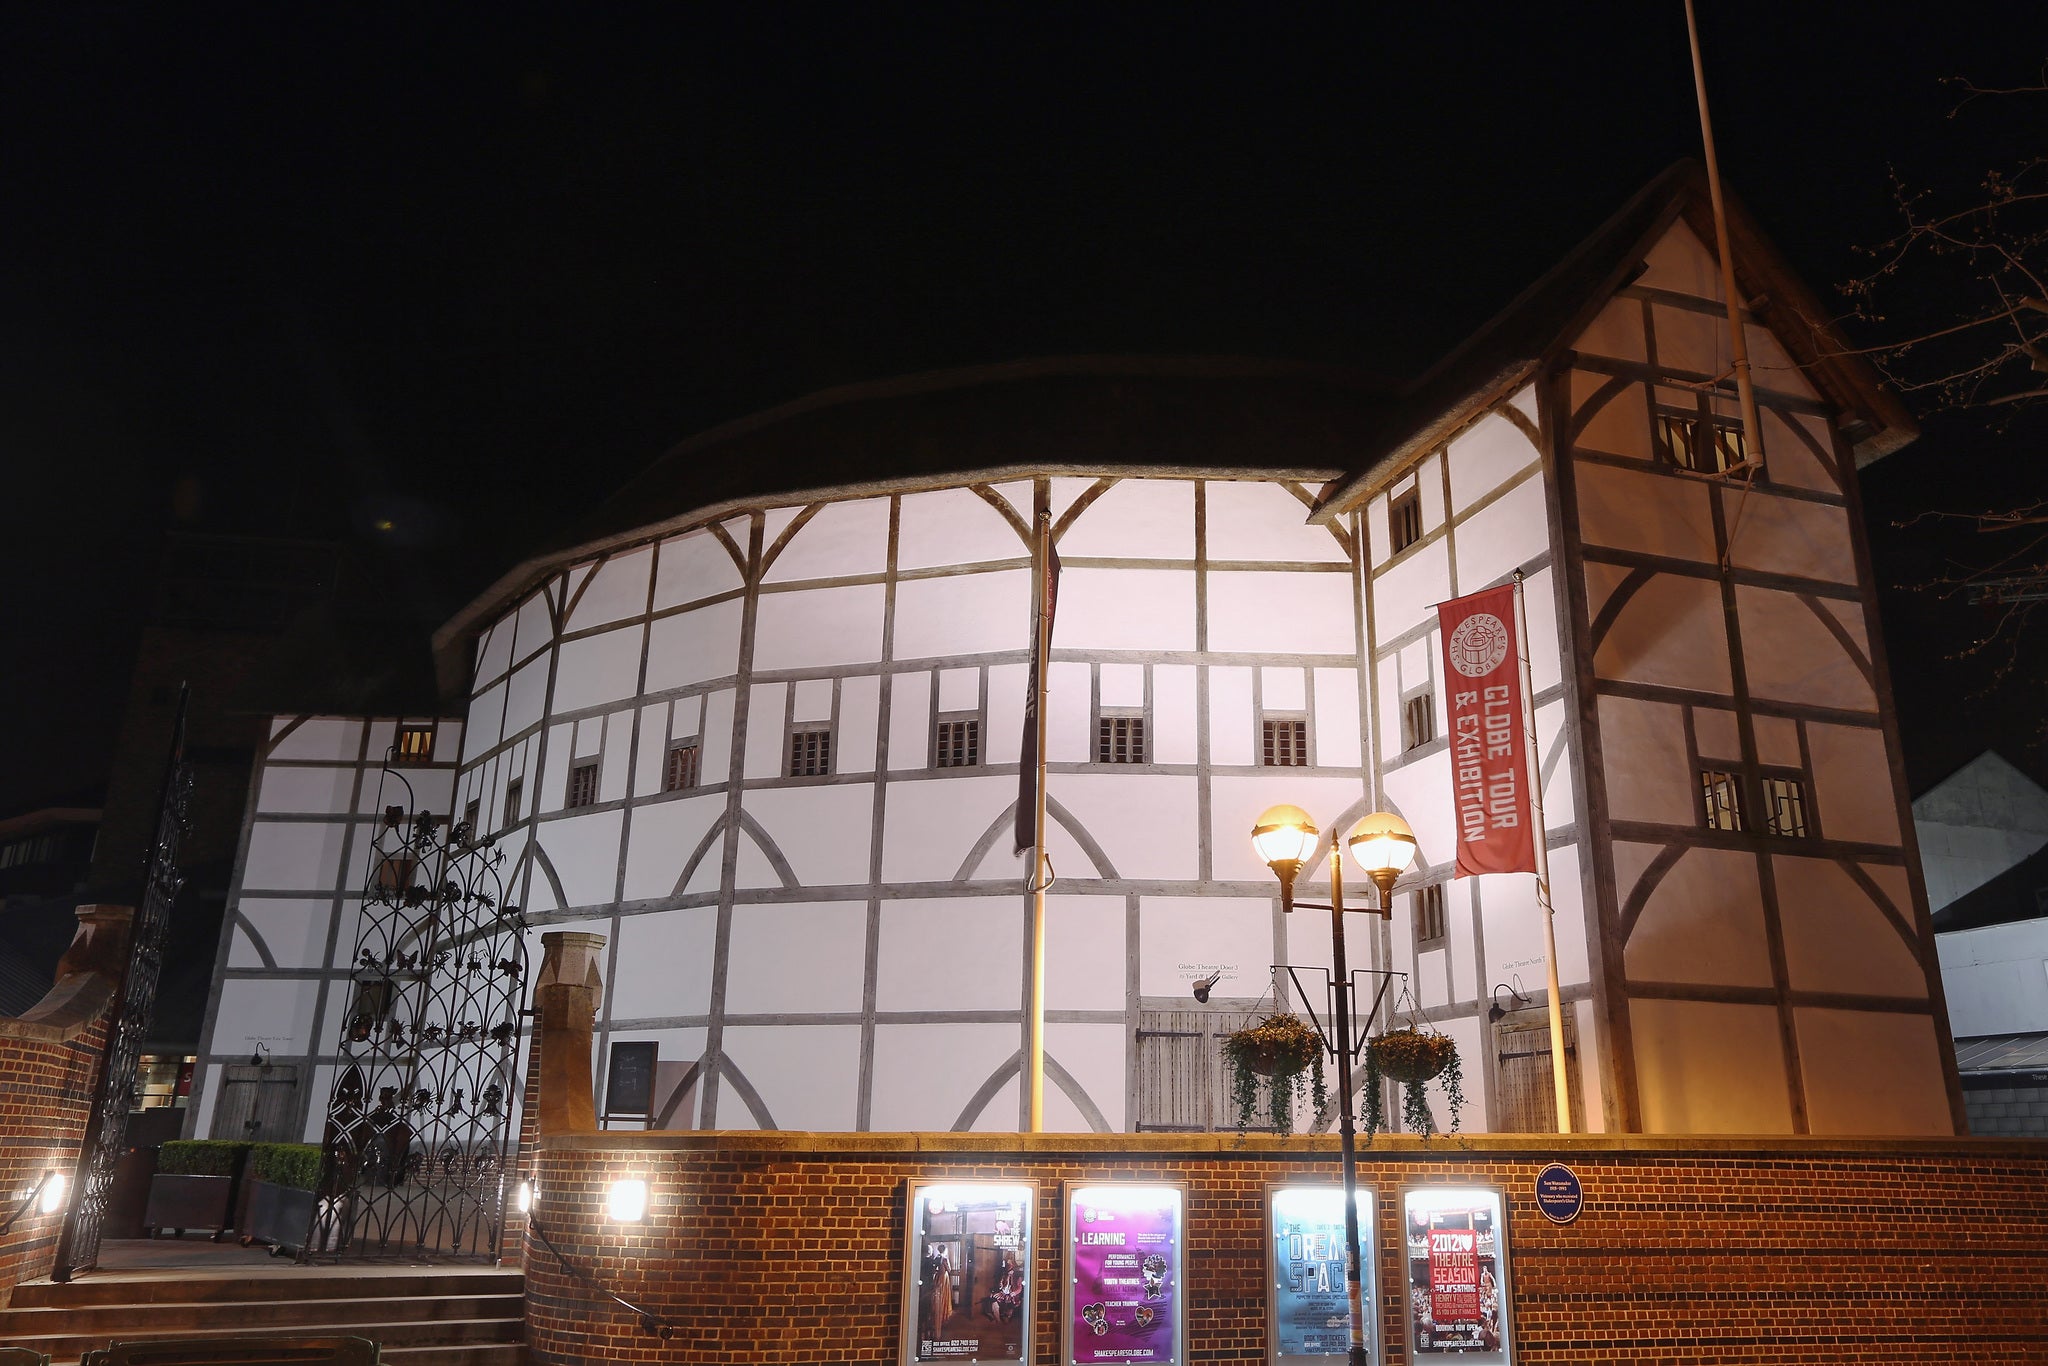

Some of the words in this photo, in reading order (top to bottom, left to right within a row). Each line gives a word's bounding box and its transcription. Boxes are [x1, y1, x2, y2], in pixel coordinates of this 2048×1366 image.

[1452, 616, 1506, 661] SHAKESPEARE'S
[1460, 657, 1499, 675] GLOBE
[1455, 690, 1478, 711] &
[1483, 684, 1513, 760] GLOBE
[1456, 713, 1486, 843] EXHIBITION
[1488, 767, 1518, 830] TOUR
[1289, 1223, 1301, 1233] THE
[994, 1235, 1020, 1246] SHREW
[1082, 1232, 1126, 1246] LEARNING
[1431, 1234, 1460, 1252] 2012
[1433, 1252, 1475, 1267] THEATRE
[1433, 1267, 1476, 1284] SEASON
[1461, 1284, 1476, 1293] THING
[1436, 1293, 1452, 1303] HENRY
[1452, 1293, 1457, 1302] V
[1435, 1324, 1455, 1332] BOOKING
[1466, 1323, 1479, 1331] OPEN
[1329, 1334, 1346, 1342] TICKETS
[1432, 1340, 1485, 1348] SHAKESPEARESGLOBE.COM
[1093, 1349, 1154, 1358] SHAKESPEARESGLOBE.COM
